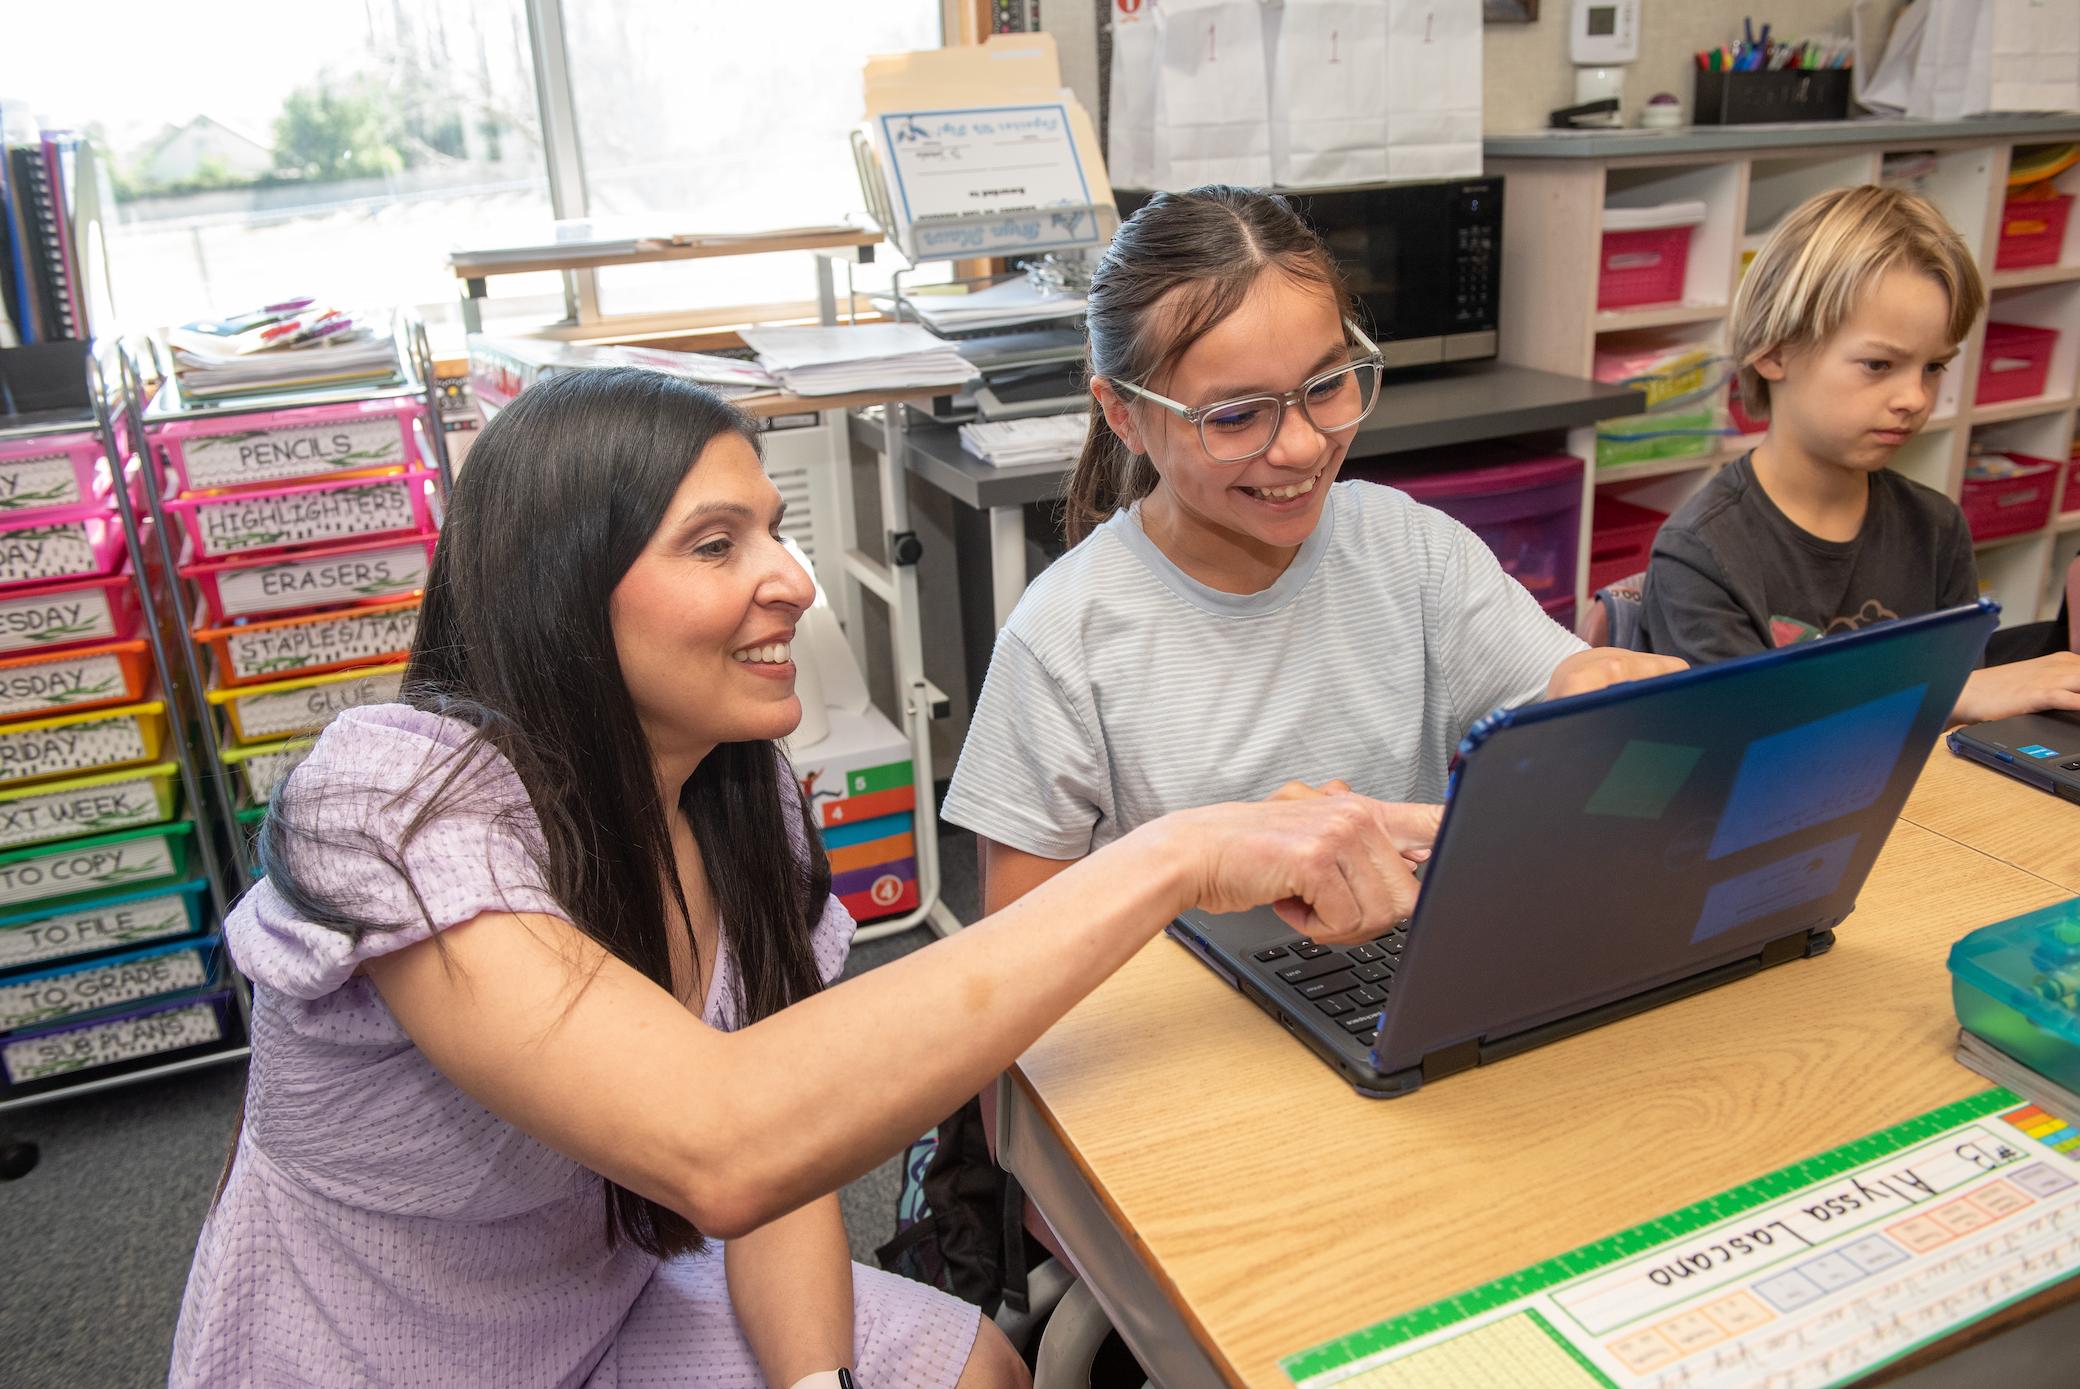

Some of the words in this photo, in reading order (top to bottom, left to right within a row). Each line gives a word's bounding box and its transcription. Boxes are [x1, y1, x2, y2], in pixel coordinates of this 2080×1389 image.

[239, 434, 352, 466] PENCILS
[207, 493, 405, 536] HIGHLIGHTERS
[261, 560, 391, 596] ERASERS
[307, 683, 377, 714] GLUE
[854, 776, 866, 791] 5
[50, 792, 132, 823] WEEK
[831, 806, 844, 820] 4
[0, 866, 43, 889] TO
[51, 850, 123, 880] COPY
[25, 925, 69, 947] TO
[76, 911, 135, 940] FILE
[22, 987, 67, 1009] TO
[74, 962, 170, 998] GRADE
[38, 1035, 92, 1062] SUB
[100, 1015, 184, 1051] PLANS
[1802, 1168, 1939, 1224] Alyssa
[1647, 1219, 1816, 1288] Lascano
